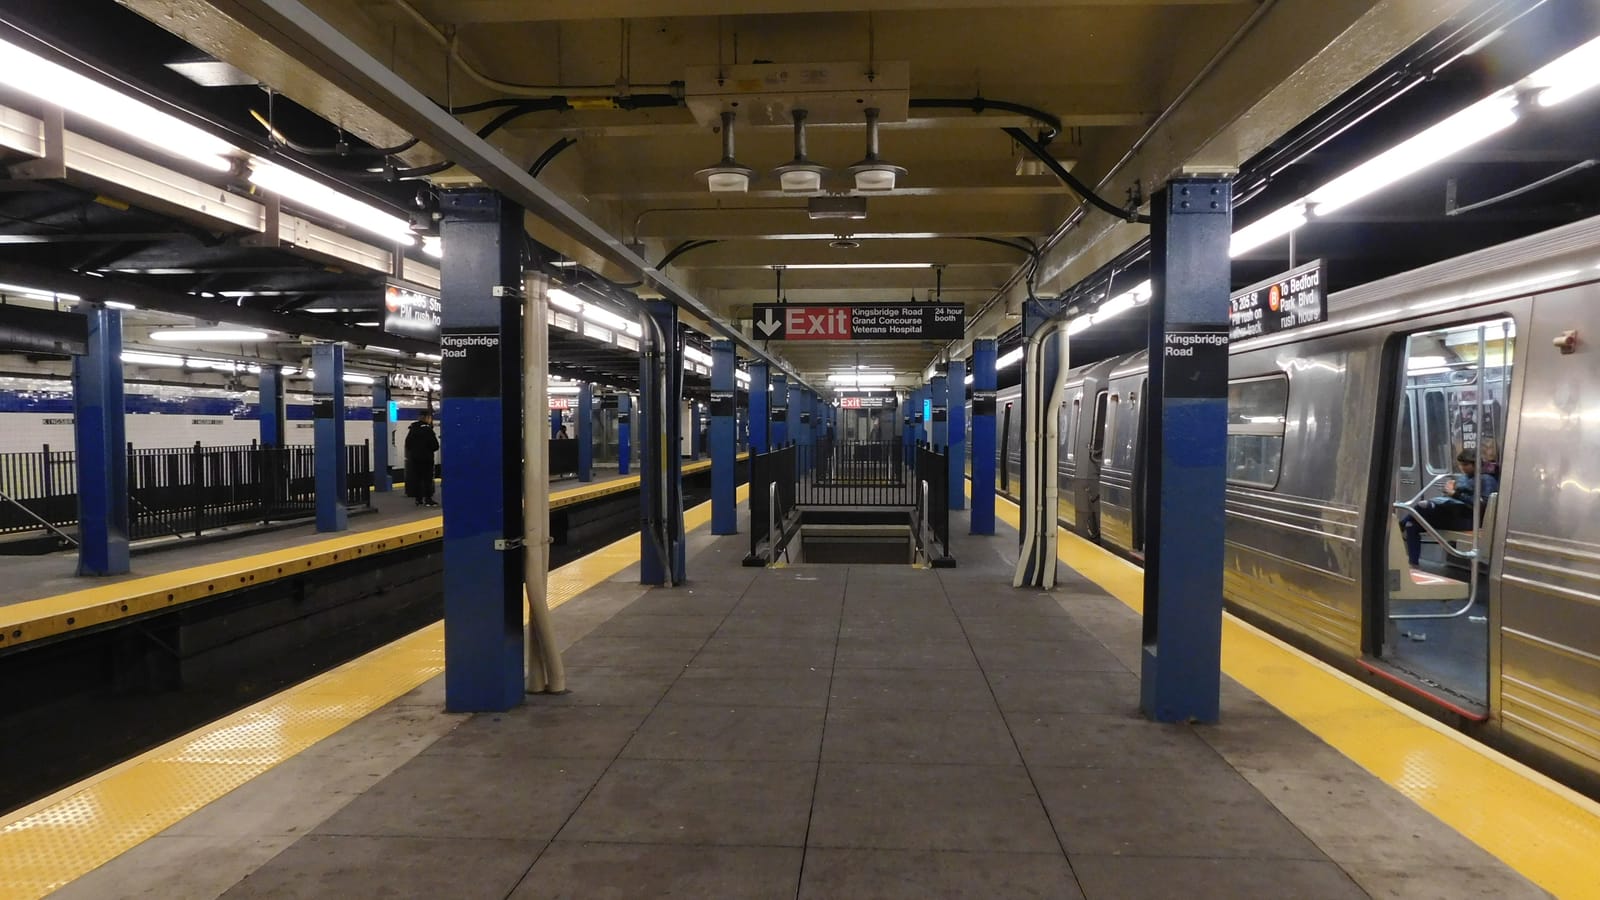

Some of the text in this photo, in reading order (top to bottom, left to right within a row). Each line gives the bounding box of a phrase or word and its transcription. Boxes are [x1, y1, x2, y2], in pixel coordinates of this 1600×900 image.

[1280, 270, 1319, 296] To Bedford
[1251, 292, 1258, 306] St
[1280, 289, 1314, 312] Park Blvd
[400, 304, 412, 320] PM
[415, 310, 430, 321] rush
[852, 308, 899, 317] Kingsbridge
[1254, 308, 1262, 319] on
[786, 308, 847, 334] Exit
[1280, 312, 1296, 328] rush
[889, 326, 922, 334] Hospital
[441, 336, 498, 347] Kingsbridge
[1165, 334, 1228, 346] Kingsbridge
[441, 349, 466, 358] Road
[1165, 347, 1193, 356] Road
[548, 399, 568, 408] Exit
[840, 398, 860, 407] Exit
